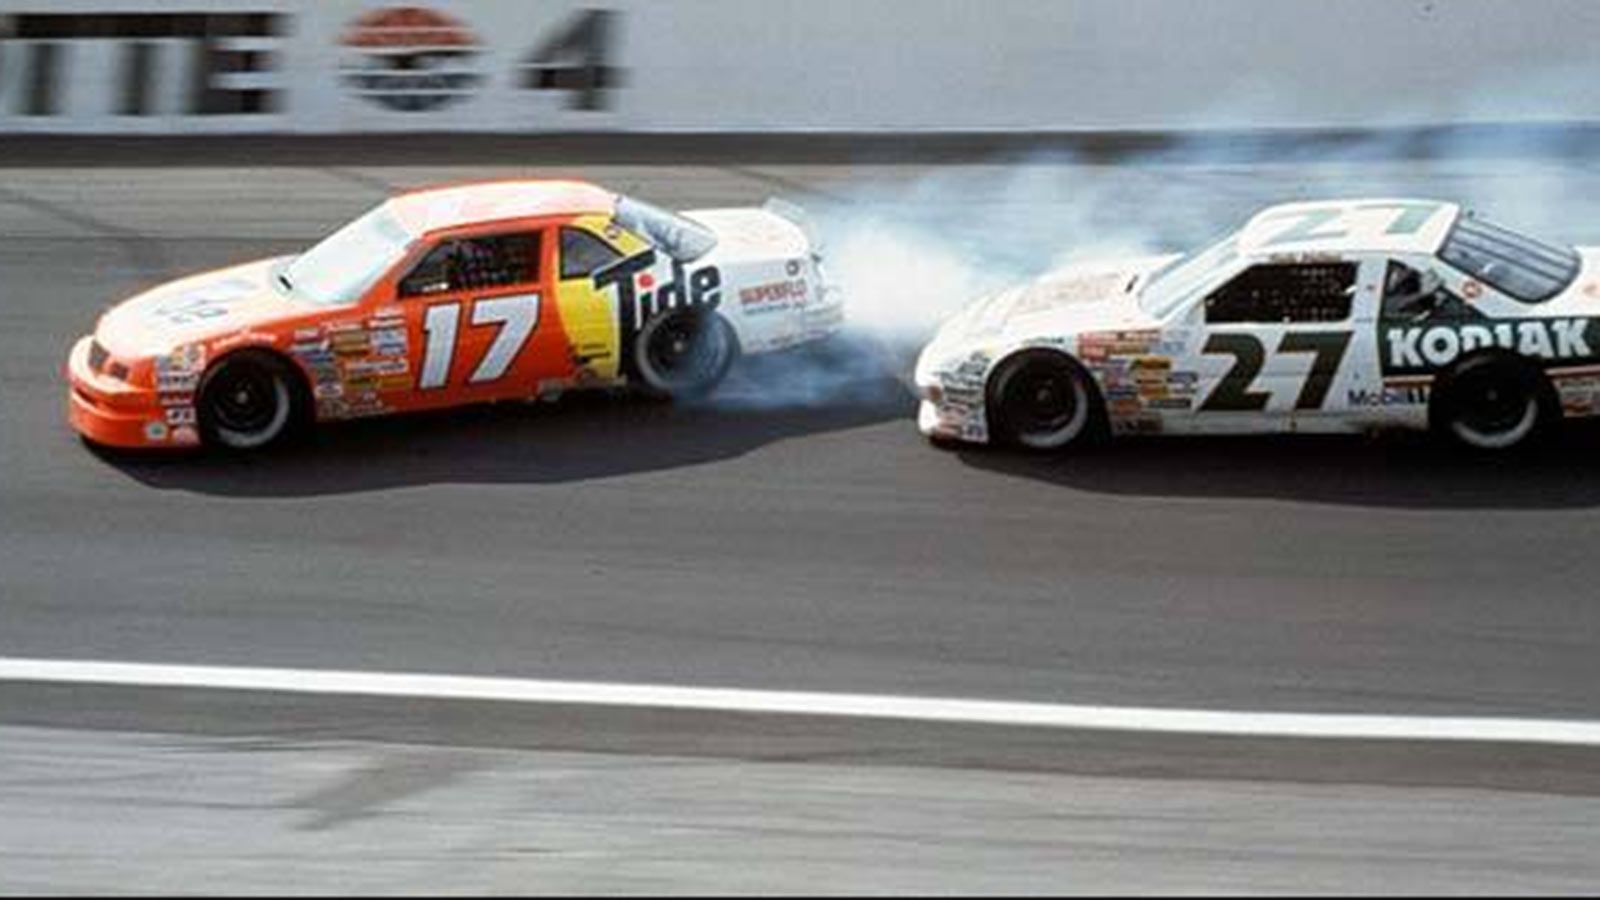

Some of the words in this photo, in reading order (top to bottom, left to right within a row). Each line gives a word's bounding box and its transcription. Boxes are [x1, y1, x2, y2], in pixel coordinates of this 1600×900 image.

[516, 8, 625, 110] 4
[418, 293, 541, 390] 17
[592, 249, 721, 345] Tide
[1387, 318, 1592, 367] KODIAK
[1199, 332, 1354, 411] 27
